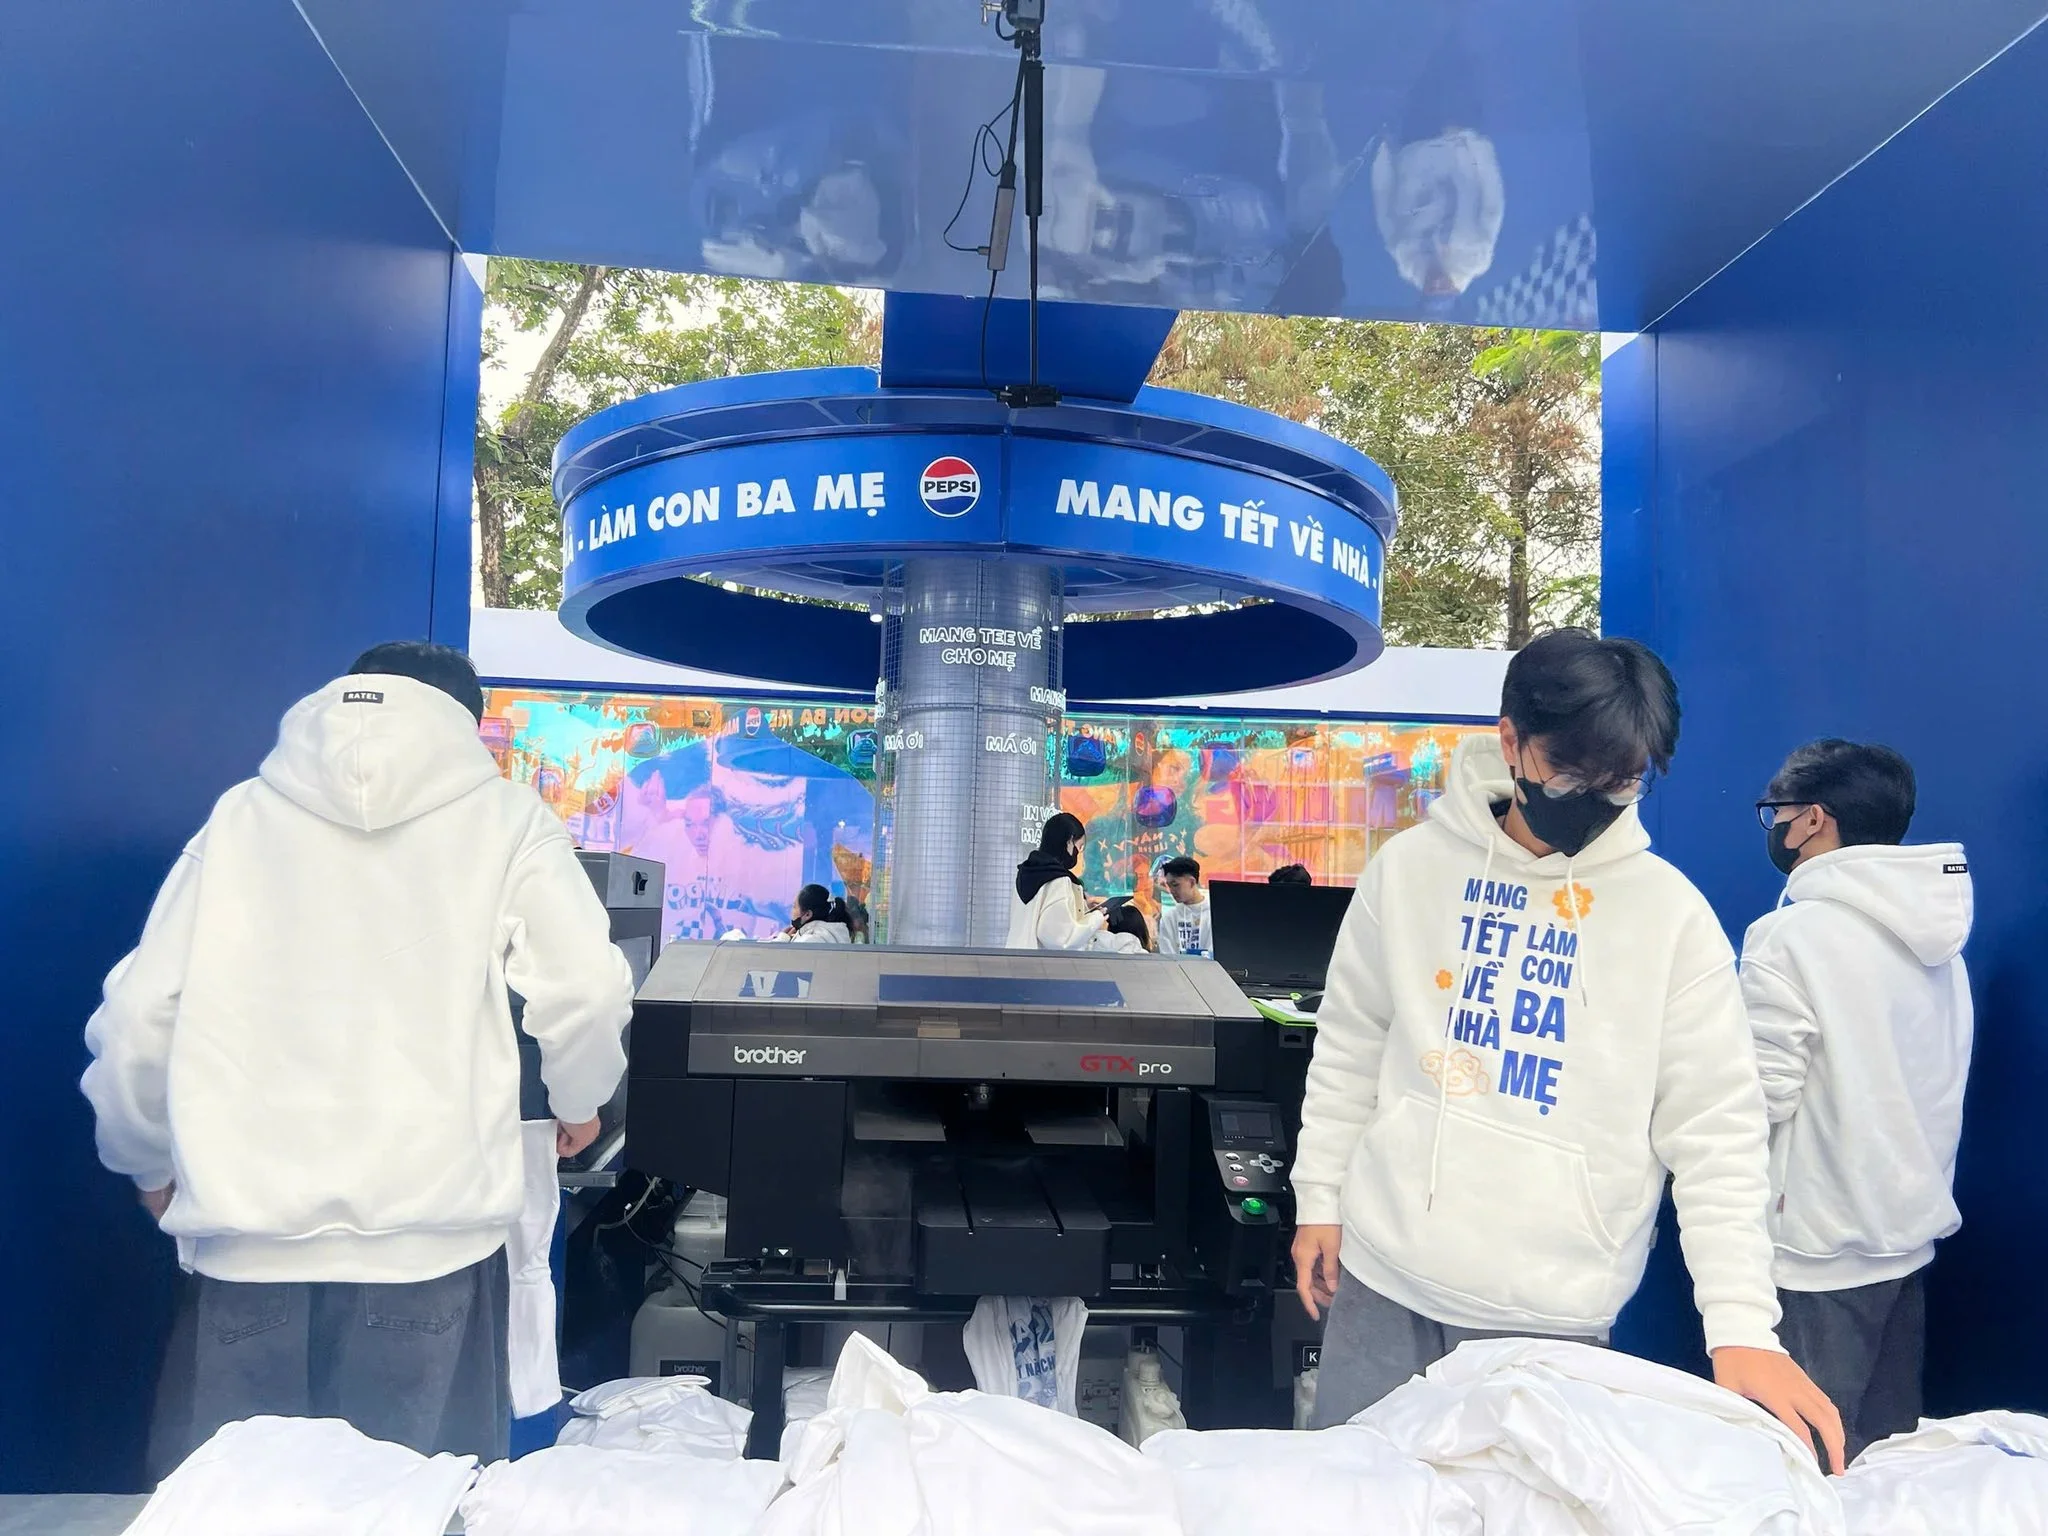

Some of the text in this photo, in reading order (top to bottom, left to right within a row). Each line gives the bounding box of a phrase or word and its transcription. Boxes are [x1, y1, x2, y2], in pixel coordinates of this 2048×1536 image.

[923, 479, 978, 494] PEPSI
[588, 503, 637, 552] LÀM
[647, 486, 719, 531] CON
[737, 478, 796, 518] BA
[813, 471, 886, 518] MẸ
[1055, 478, 1205, 532] MANG
[1219, 499, 1279, 548] TẾT
[1289, 514, 1324, 565] VỀ
[1332, 537, 1370, 587] NHÀ
[919, 627, 976, 643] MANG
[979, 628, 1016, 646] TEE
[941, 648, 1017, 672] CHO MẸ
[884, 728, 905, 751] MÁ
[985, 733, 1037, 756] MÁ ƠI
[1023, 804, 1039, 821] IN
[1464, 877, 1528, 911] MANG
[1461, 912, 1519, 958] TẾT
[1526, 922, 1578, 958] LÀM
[1461, 960, 1504, 1005] VỀ
[1520, 955, 1573, 989] CON
[1446, 1006, 1501, 1051] NHÀ
[1510, 988, 1566, 1043] BA
[734, 1046, 807, 1064] brother
[1080, 1055, 1172, 1076] GTX pro
[1498, 1049, 1563, 1116] MẸ
[673, 1364, 707, 1374] brother
[1309, 1351, 1318, 1362] K
